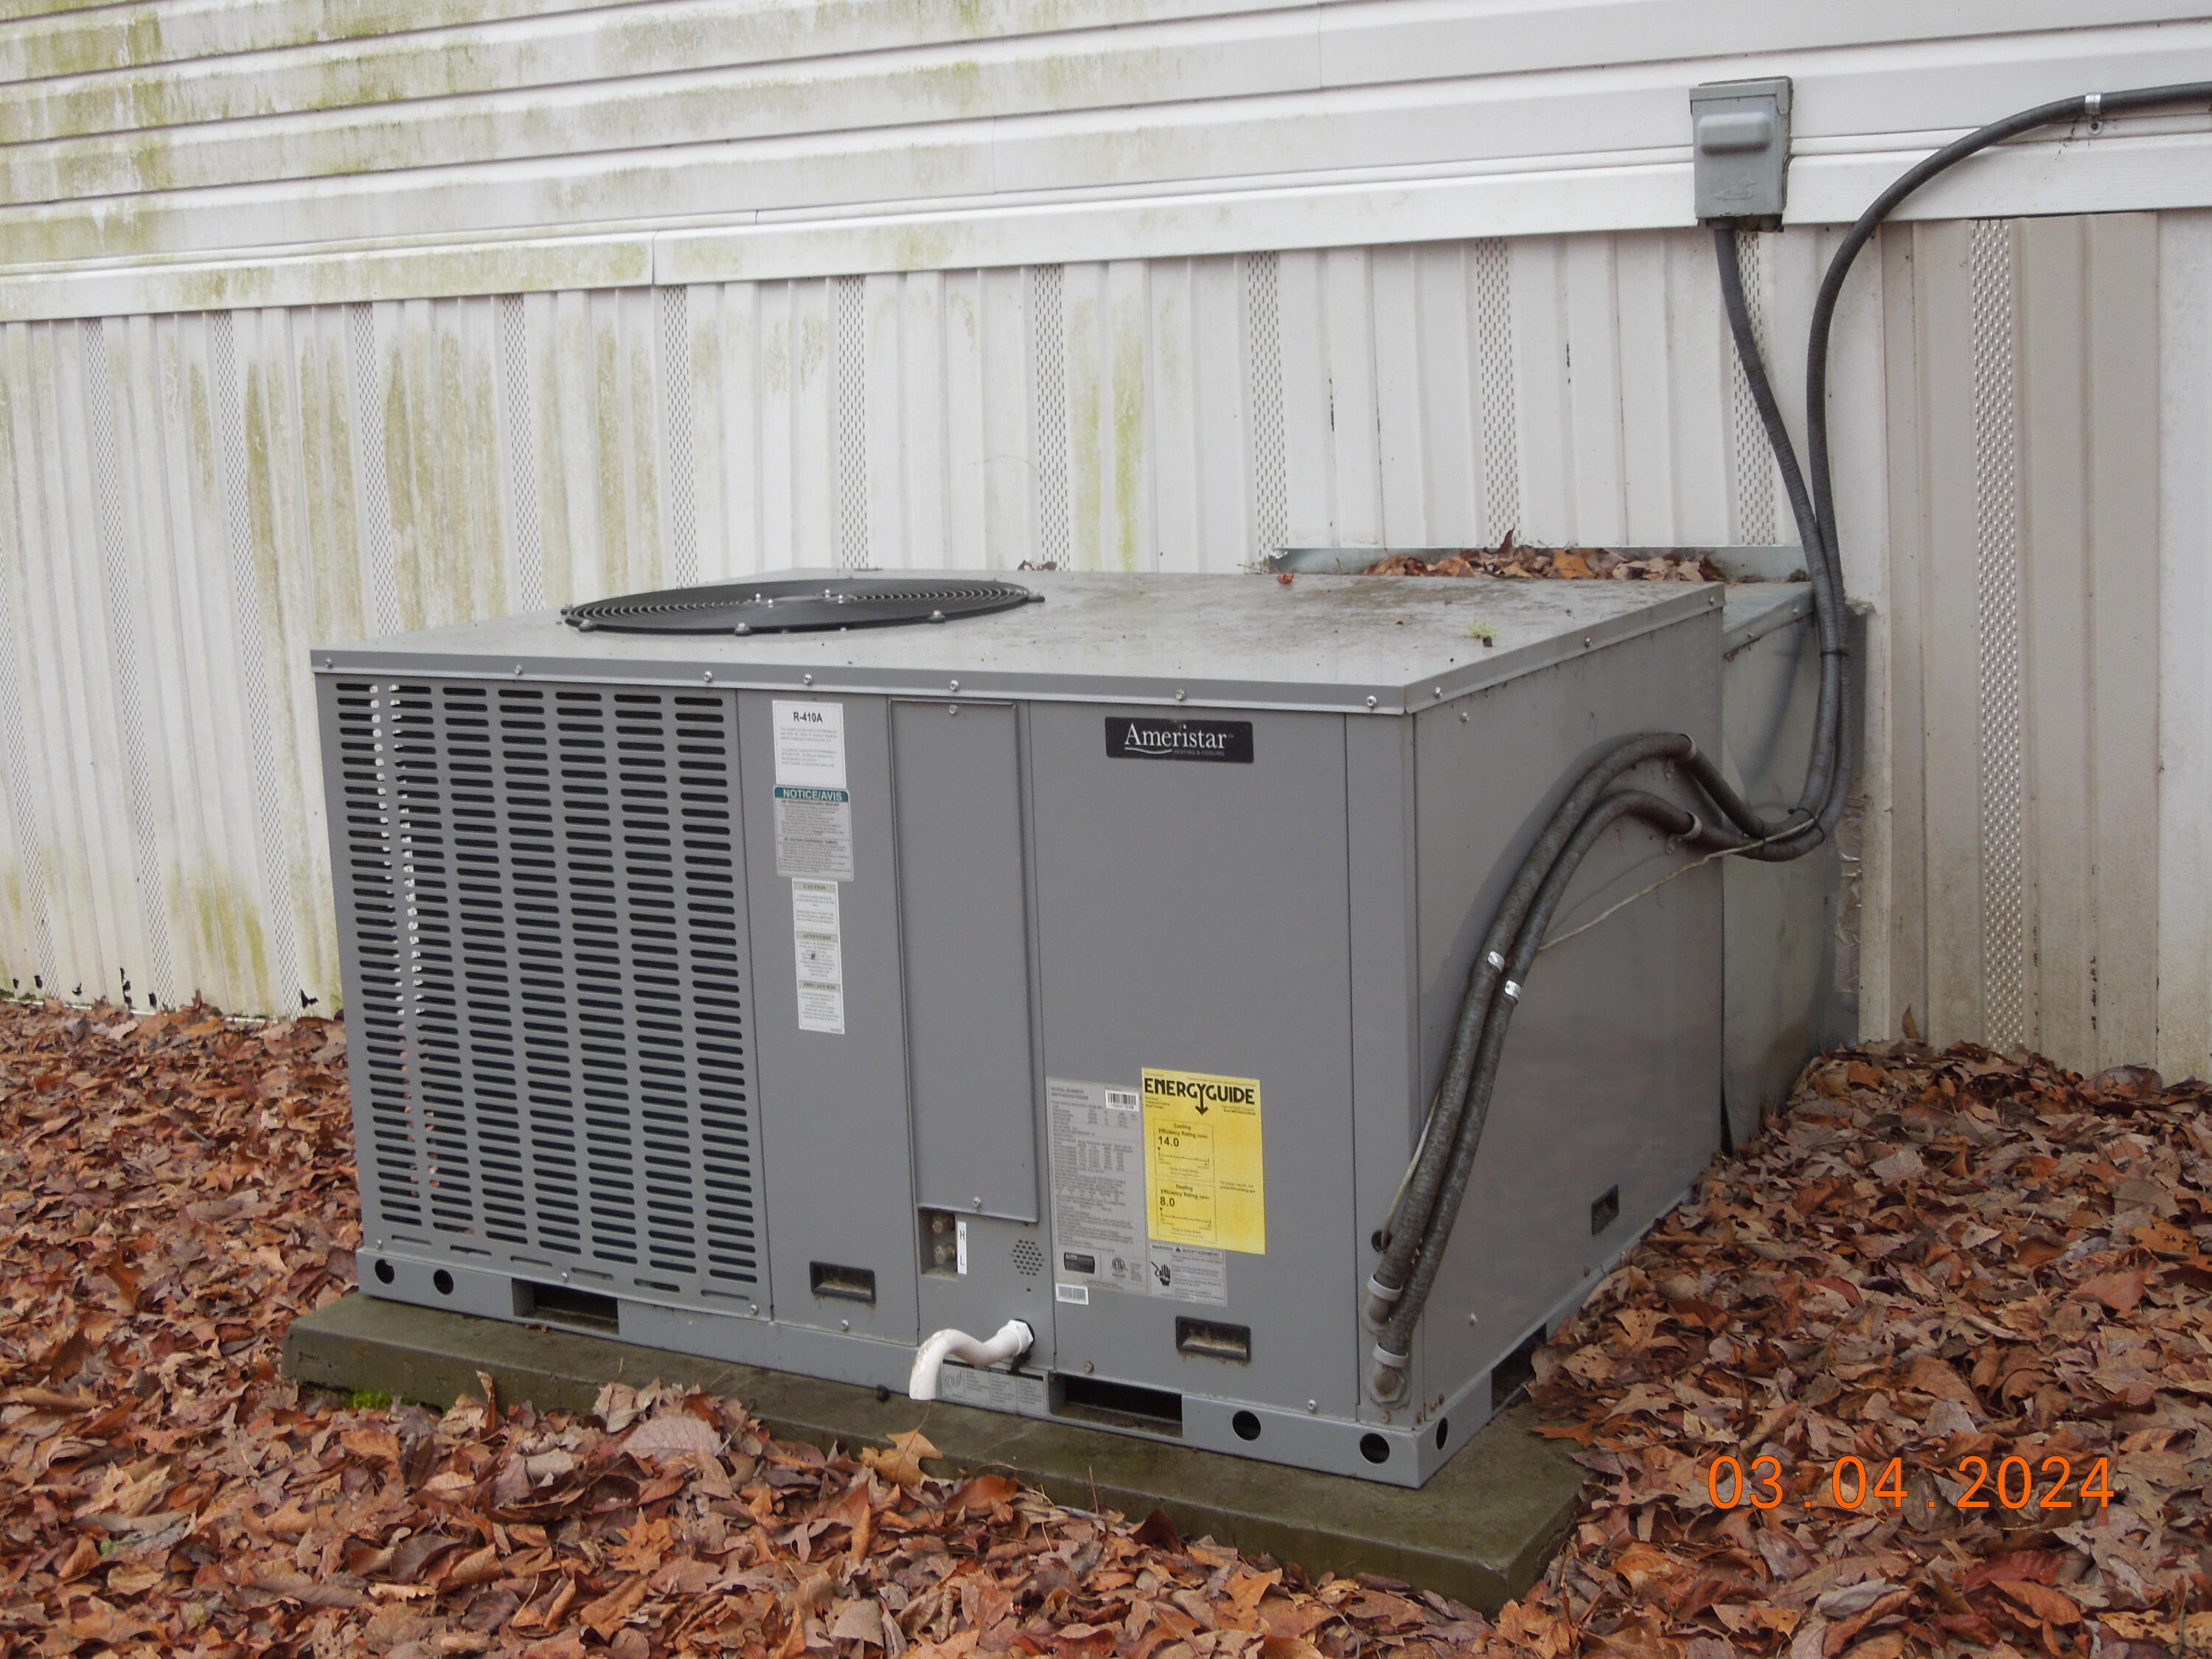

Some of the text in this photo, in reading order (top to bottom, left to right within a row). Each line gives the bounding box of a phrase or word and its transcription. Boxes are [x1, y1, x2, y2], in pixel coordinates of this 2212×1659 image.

[793, 712, 823, 723] R-410A
[1124, 723, 1227, 749] Ameristar
[783, 788, 842, 802] NOTICE/AVIS
[1144, 1078, 1255, 1105] ENERGYGUIDE
[1158, 1136, 1179, 1147] 14.0
[1160, 1197, 1175, 1207] 8.0
[960, 1230, 965, 1241] H
[960, 1255, 965, 1266] L
